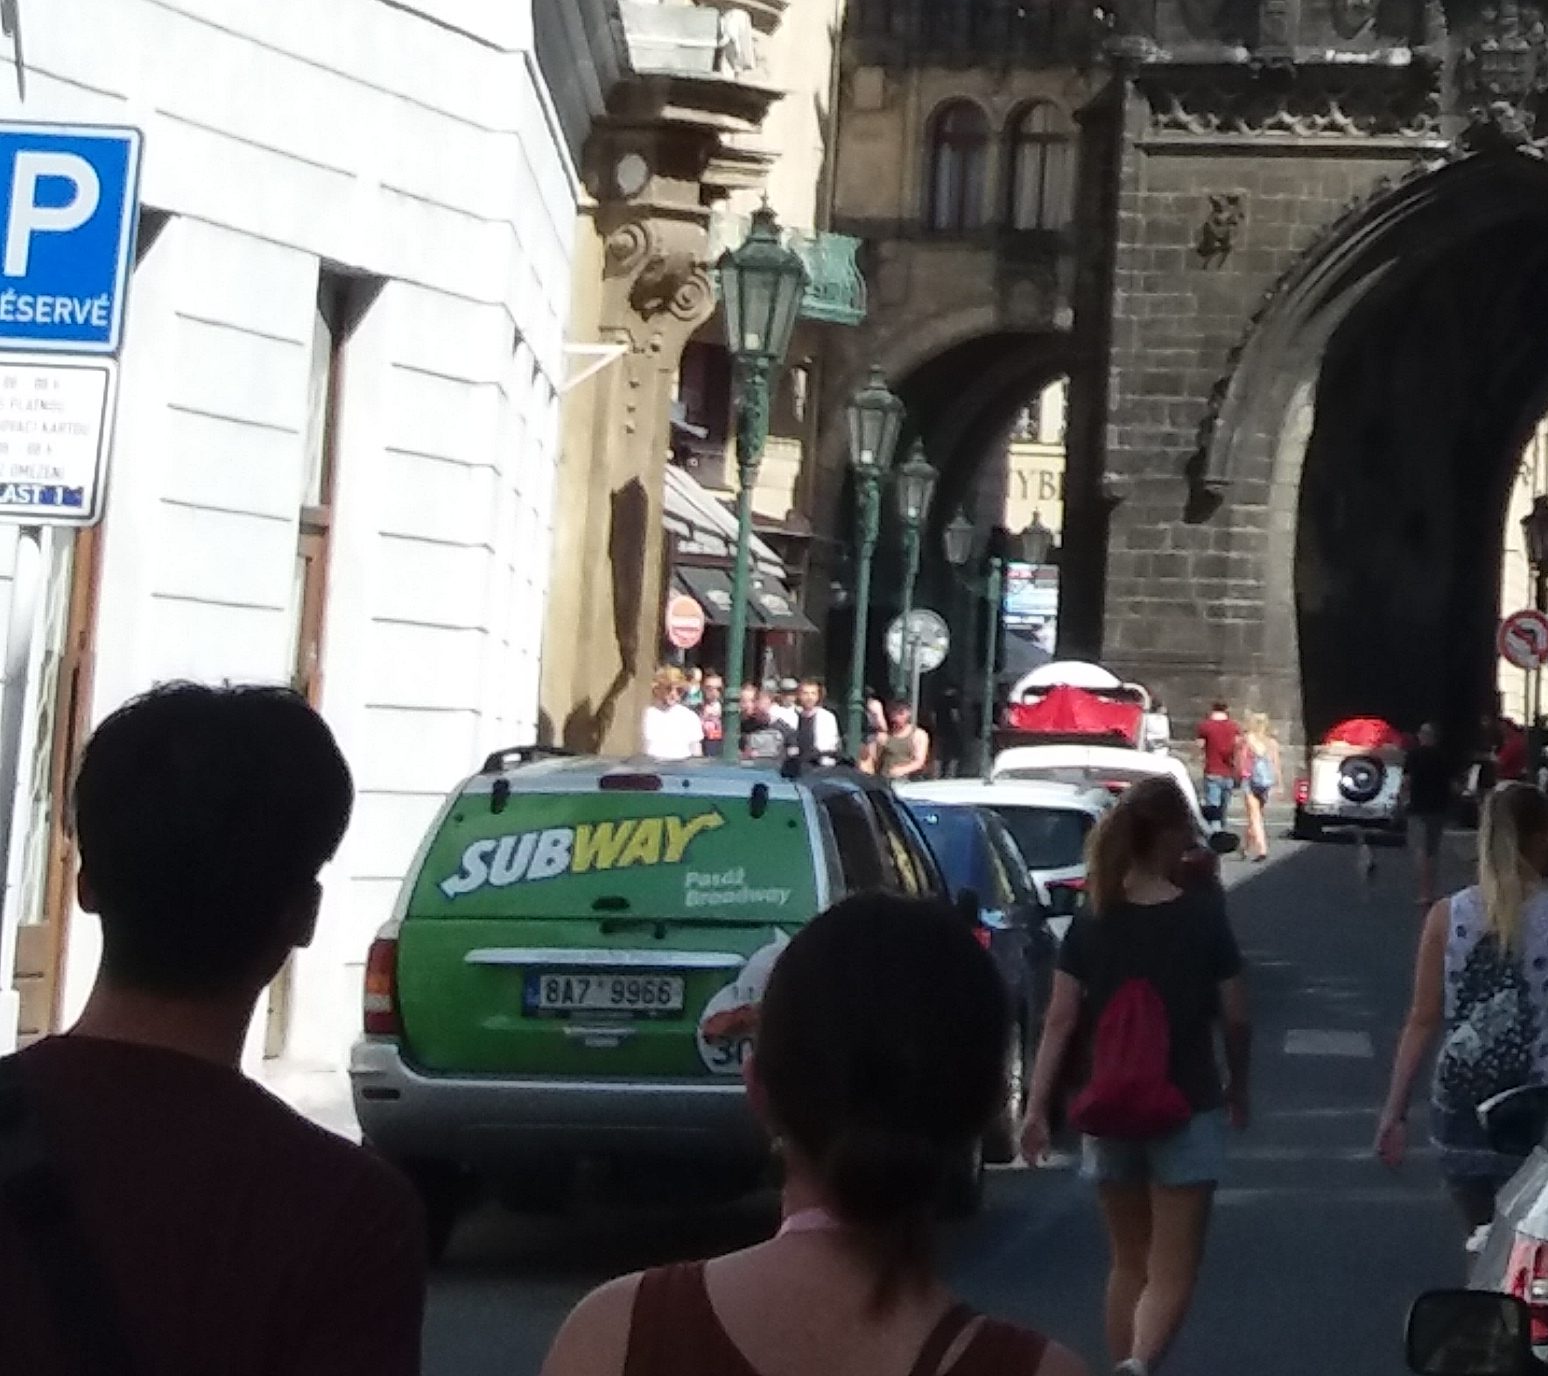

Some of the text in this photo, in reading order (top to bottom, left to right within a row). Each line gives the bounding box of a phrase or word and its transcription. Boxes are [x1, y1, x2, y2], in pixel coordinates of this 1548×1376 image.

[4, 150, 101, 277] P
[438, 809, 725, 899] SUBWAY
[546, 979, 672, 1005] 8A7 9966
